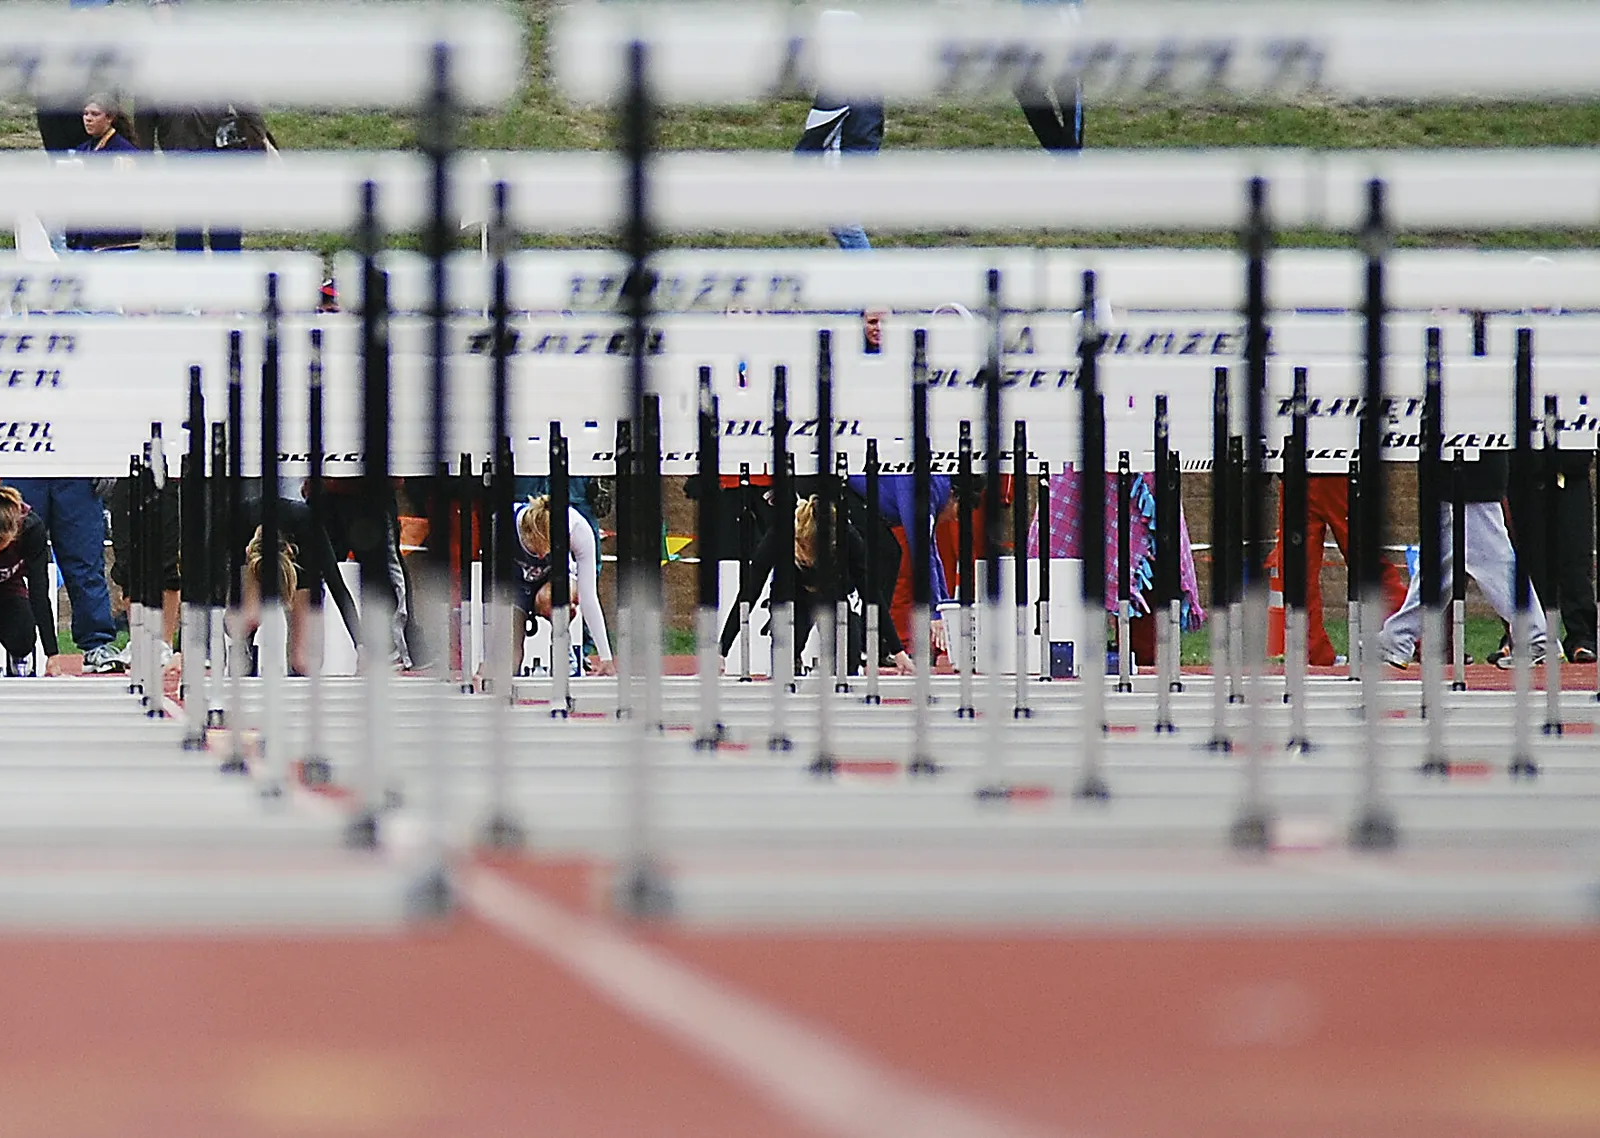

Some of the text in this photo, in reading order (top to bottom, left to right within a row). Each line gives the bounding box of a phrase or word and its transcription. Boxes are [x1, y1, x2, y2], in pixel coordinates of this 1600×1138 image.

[1077, 332, 1278, 355] LAZE
[724, 420, 863, 436] BLZR
[1381, 433, 1510, 448] BLZER
